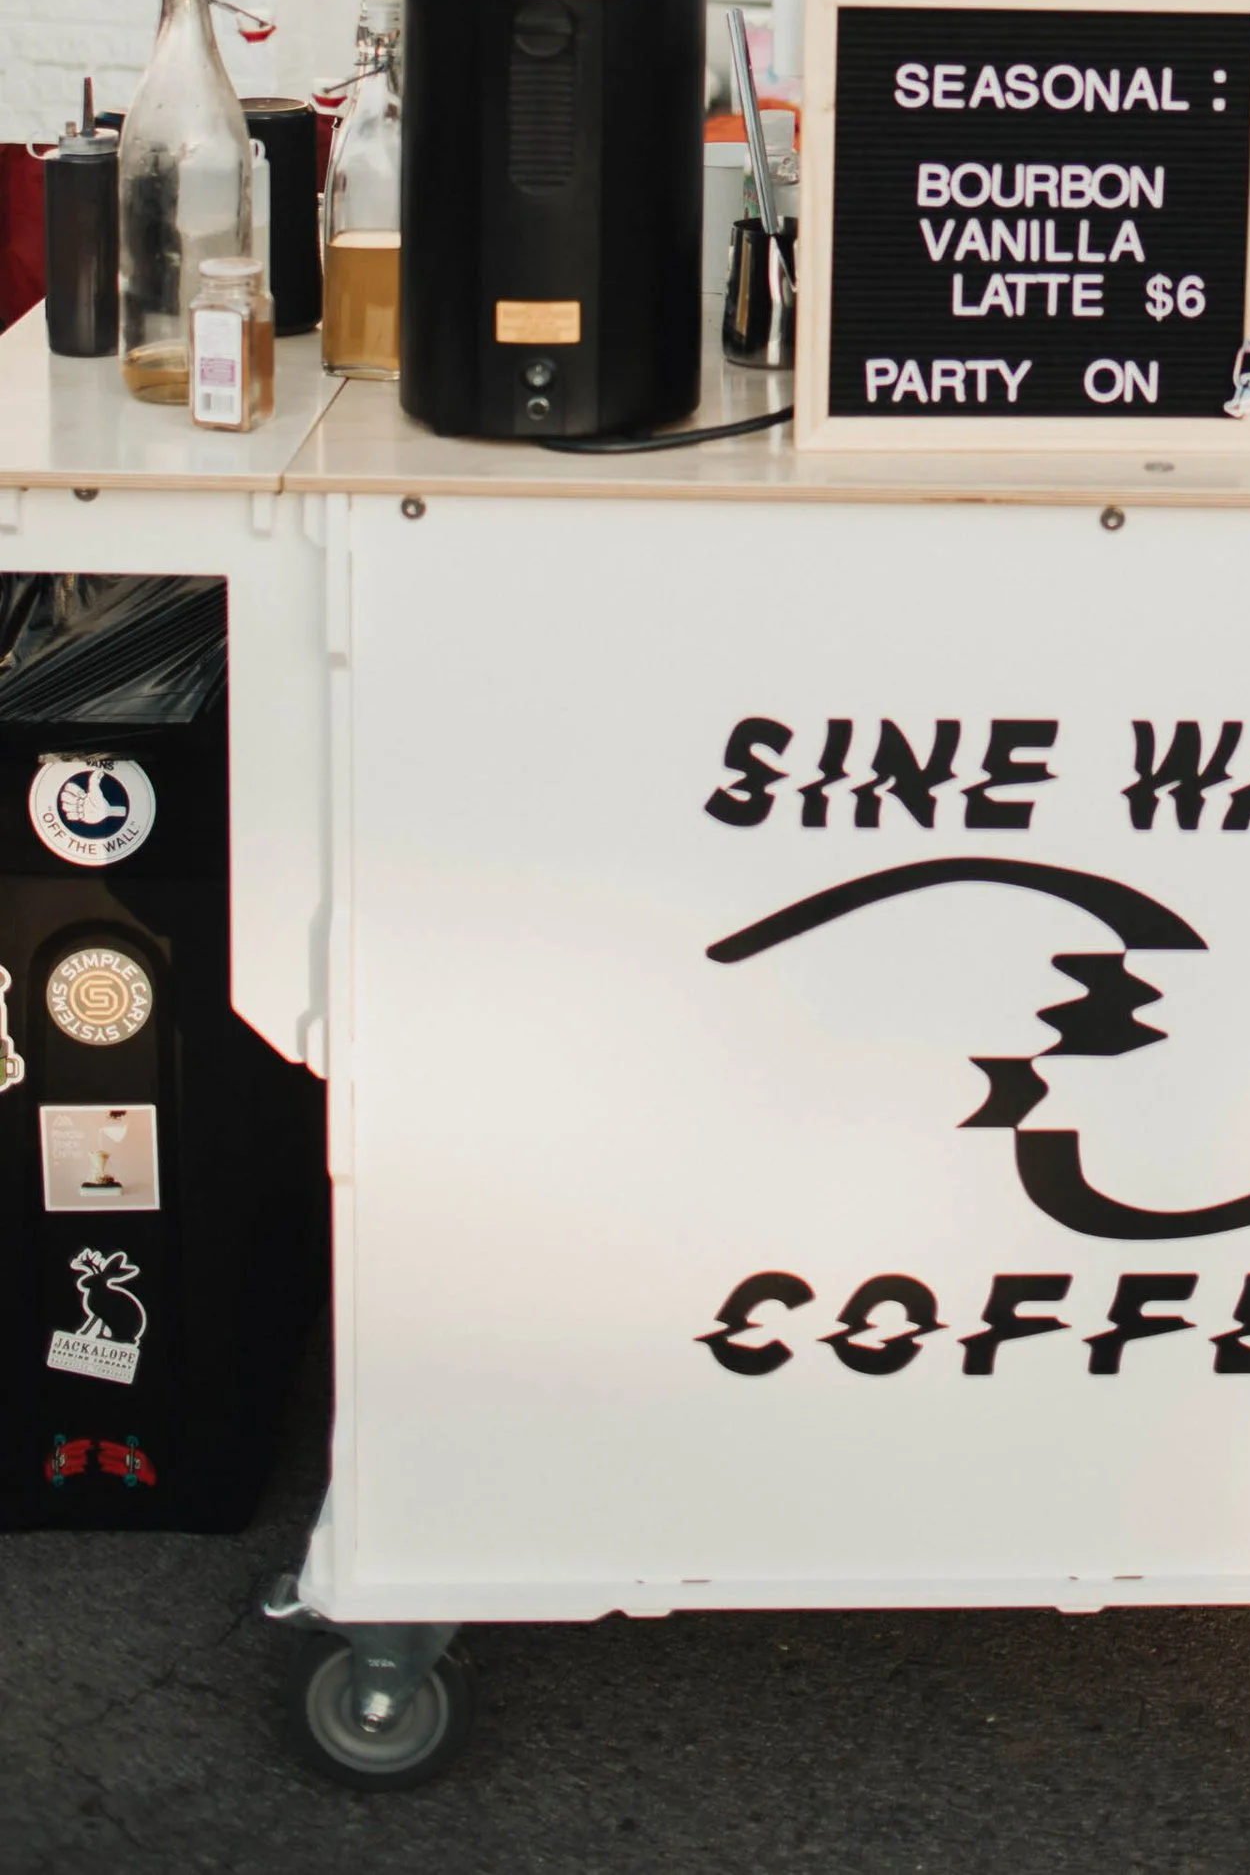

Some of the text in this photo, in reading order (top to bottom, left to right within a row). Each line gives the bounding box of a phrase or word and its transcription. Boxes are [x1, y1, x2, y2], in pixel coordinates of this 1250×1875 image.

[917, 163, 1165, 208] BOURBON
[920, 218, 1146, 263] VANILLA
[952, 273, 1206, 322] LATTE $6
[865, 358, 1159, 403] PARTY ON
[704, 717, 1059, 830] SINE
[67, 837, 97, 855] THE
[52, 952, 148, 1042] SIMPLE CART SYSTEMS
[54, 1338, 137, 1364] JACKALOPE
